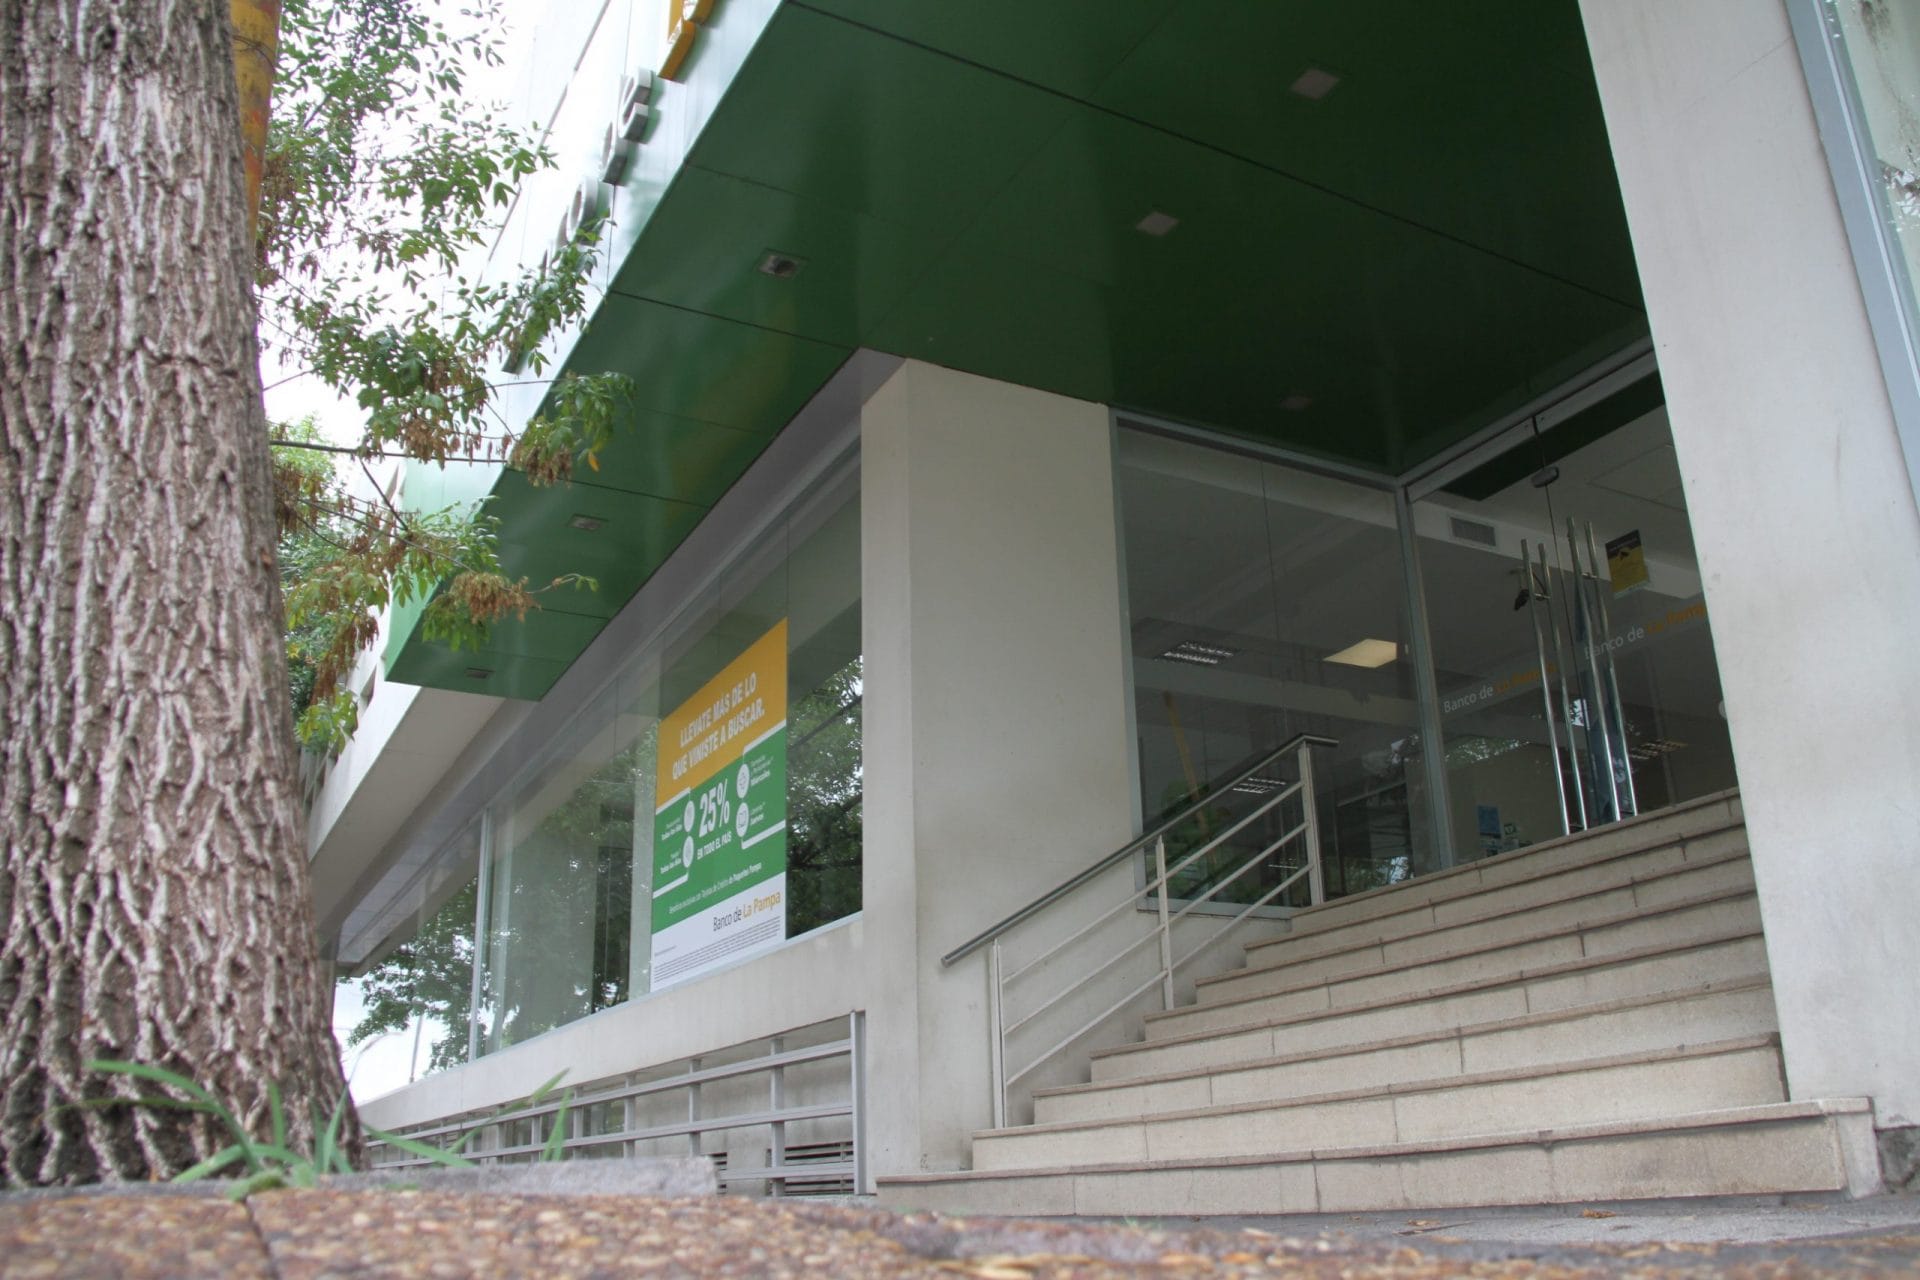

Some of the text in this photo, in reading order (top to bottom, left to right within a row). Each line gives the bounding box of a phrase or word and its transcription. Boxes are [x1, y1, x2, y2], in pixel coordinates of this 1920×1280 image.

[1627, 627, 1646, 643] de
[731, 683, 743, 706] DE
[744, 672, 757, 697] LO
[1443, 692, 1477, 714] Banco
[1478, 685, 1494, 699] de
[672, 754, 687, 780] QUE
[689, 733, 718, 767] VINISTE
[719, 725, 727, 746] A
[698, 778, 730, 838] 25%
[713, 892, 781, 932] Banco de La Pampa
